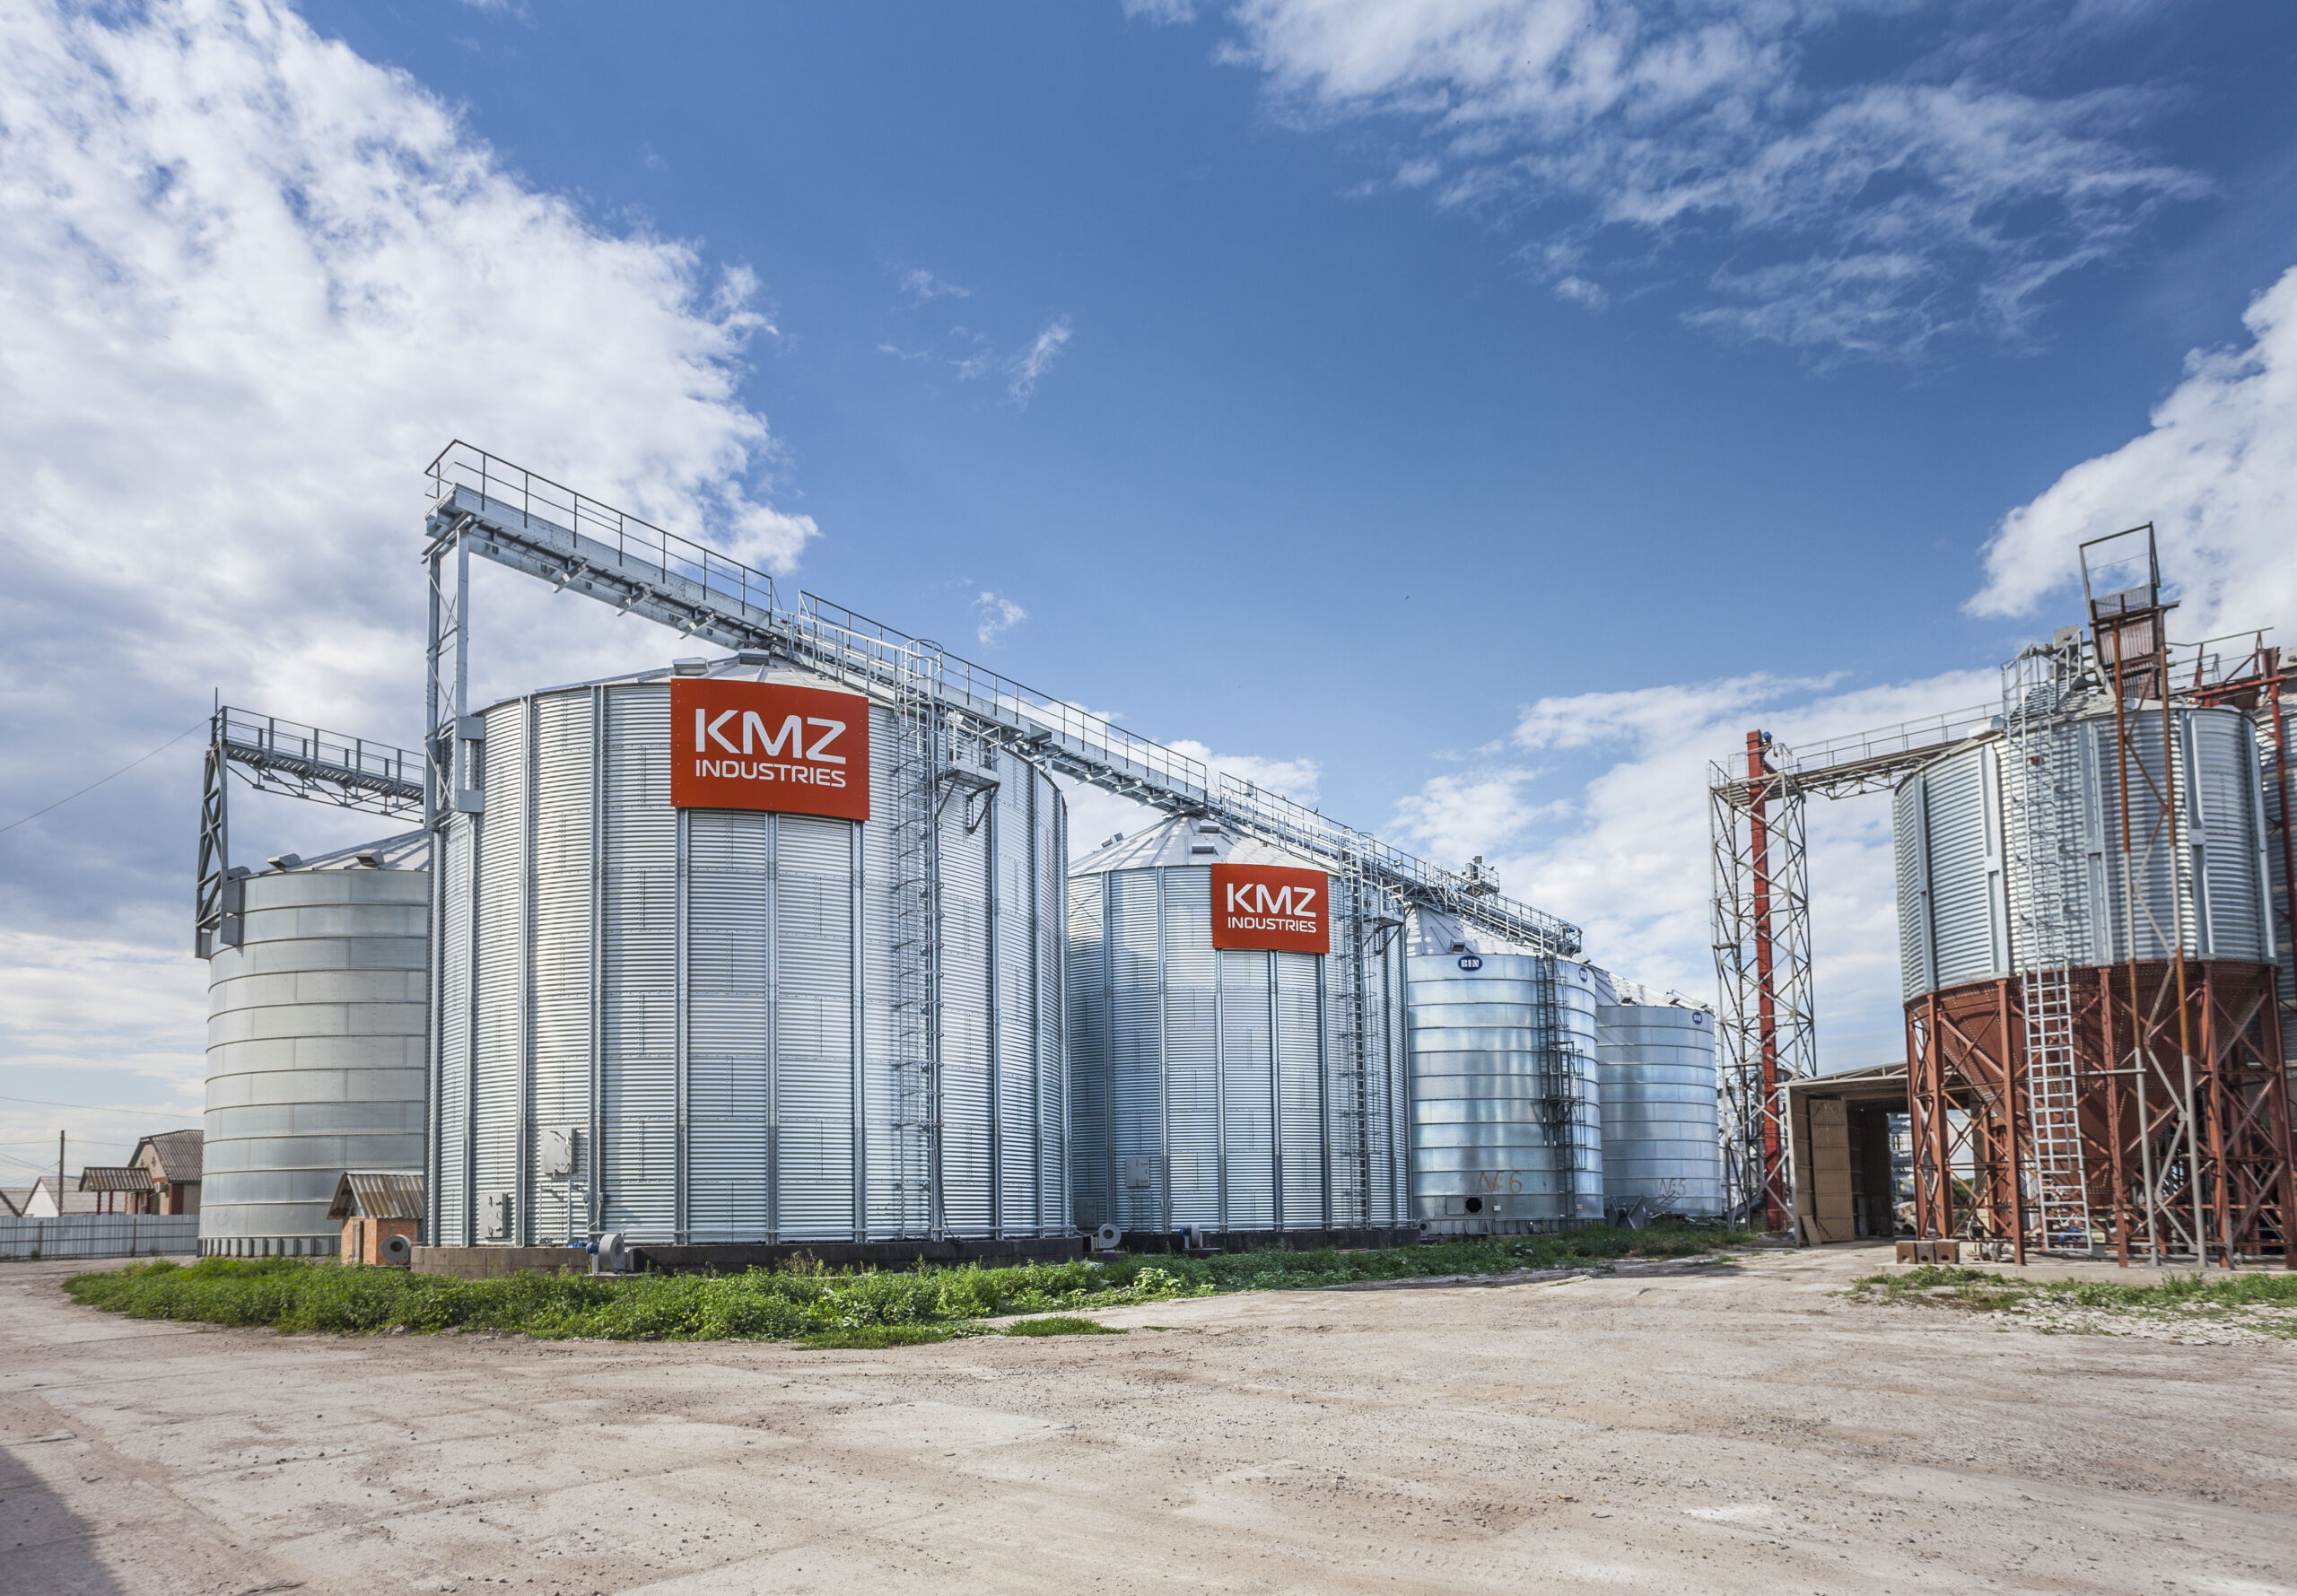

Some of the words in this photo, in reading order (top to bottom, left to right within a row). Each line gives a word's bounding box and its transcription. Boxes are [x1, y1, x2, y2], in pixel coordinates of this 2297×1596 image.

[695, 708, 846, 764] KMZ
[695, 759, 846, 788] INDUSTRIES
[1227, 883, 1316, 918] KMZ
[1227, 916, 1317, 934] INDUSTRIES
